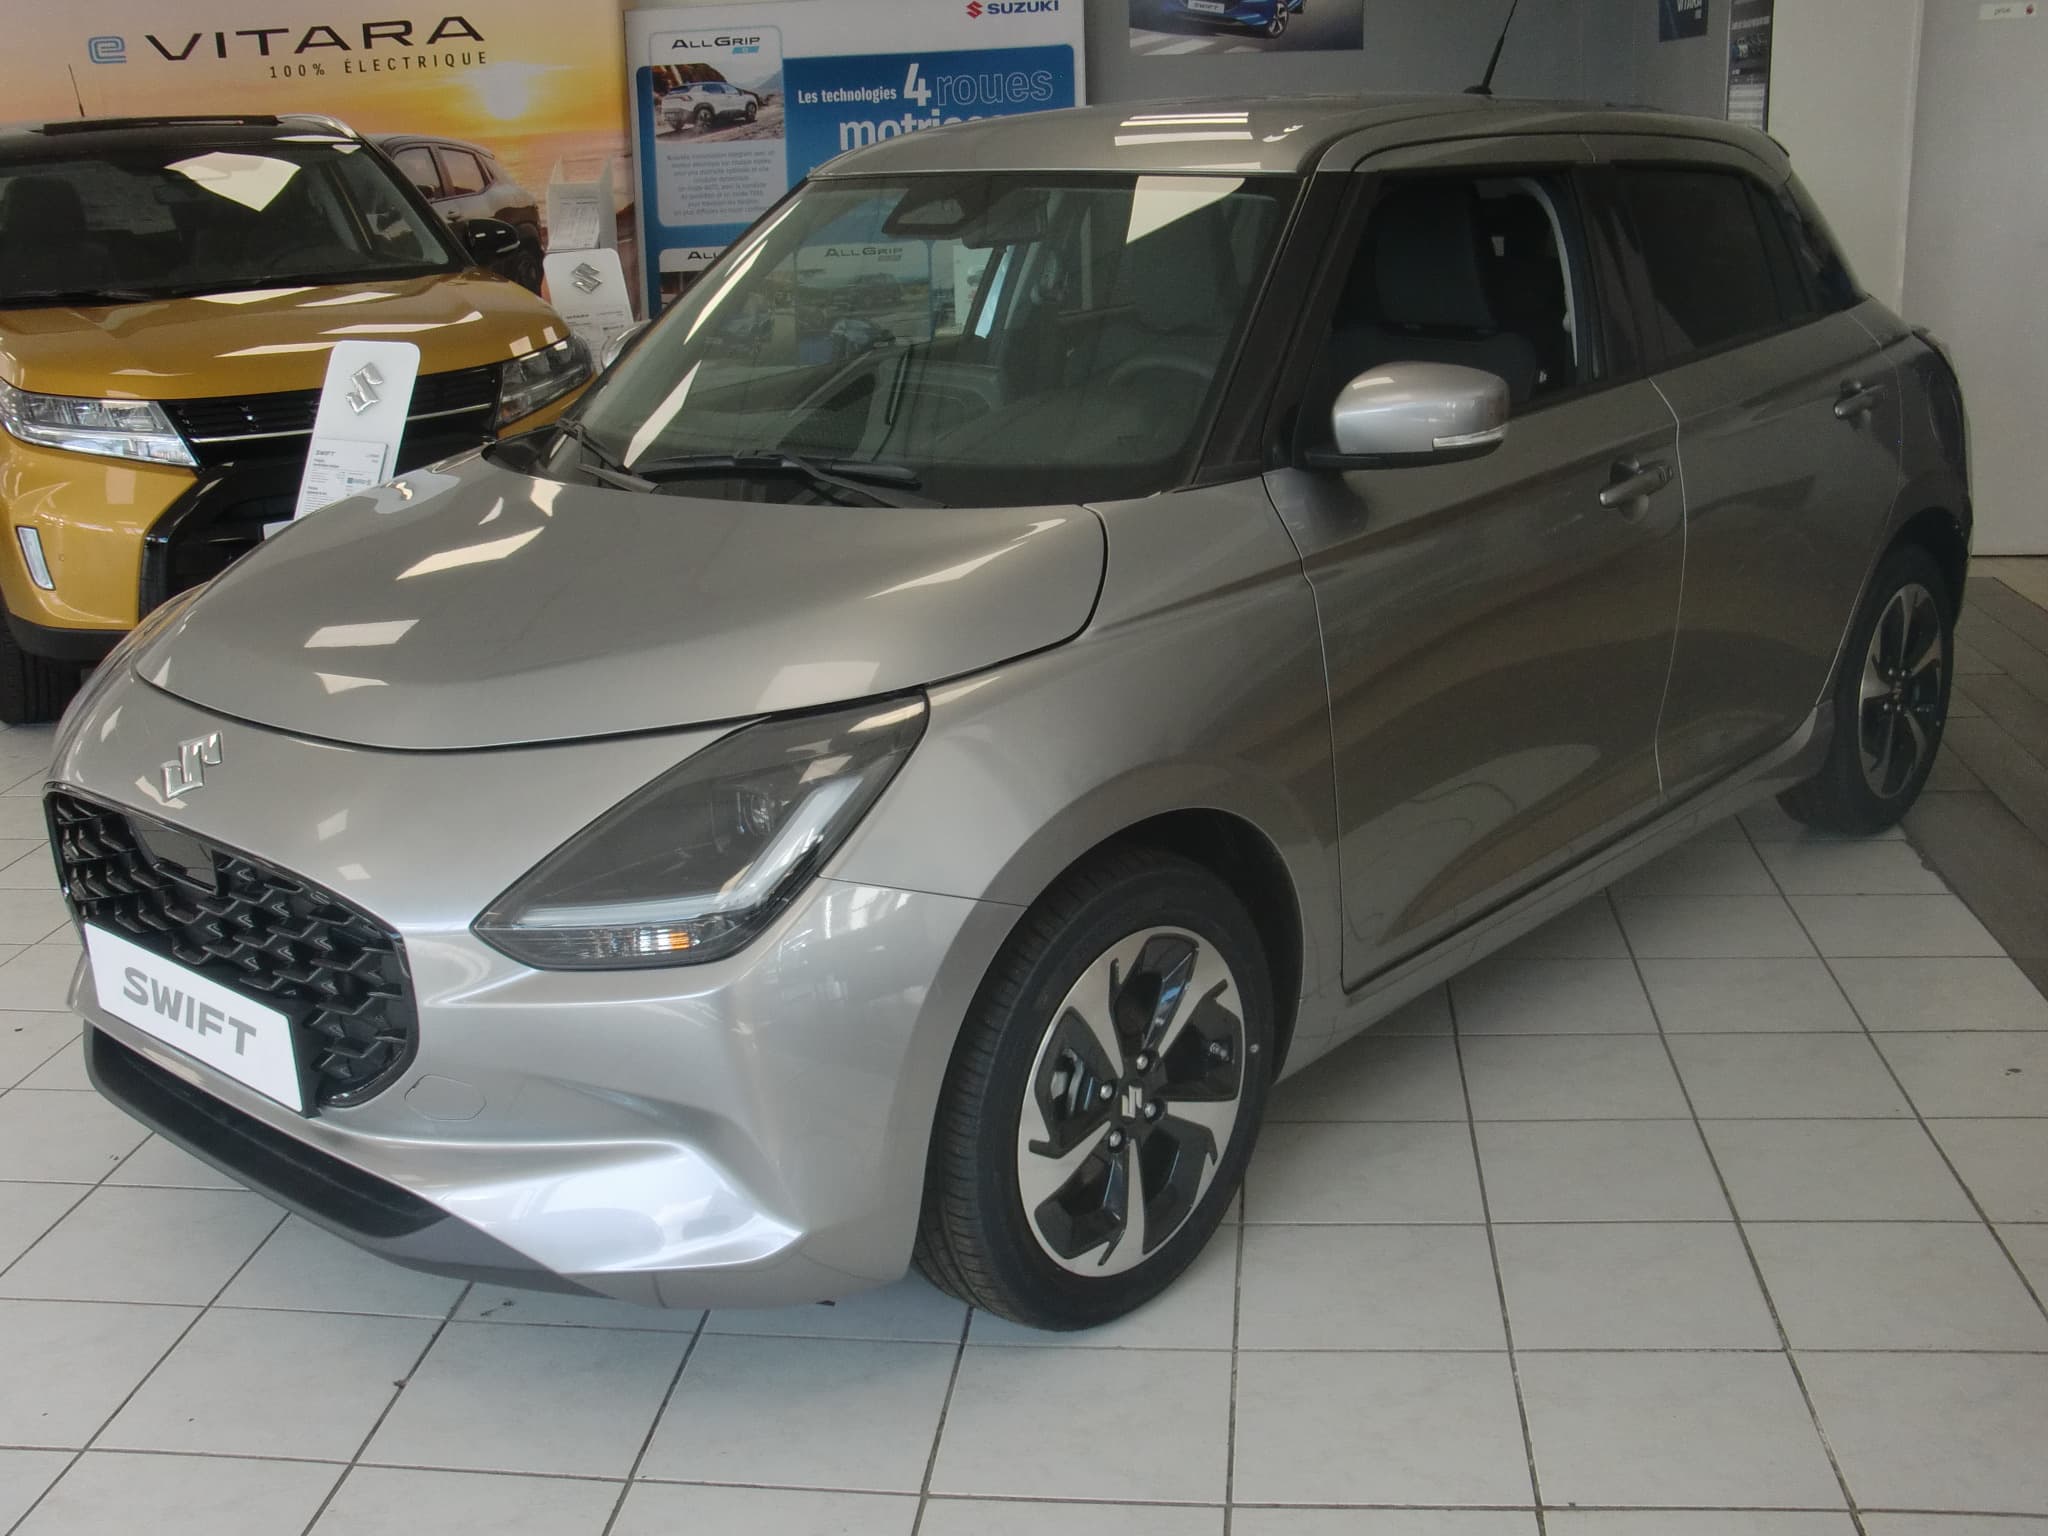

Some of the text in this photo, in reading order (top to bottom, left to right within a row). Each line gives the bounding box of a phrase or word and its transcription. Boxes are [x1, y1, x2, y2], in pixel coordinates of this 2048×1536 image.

[987, 0, 1060, 15] SUZUKI
[144, 16, 486, 61] VITARA
[269, 51, 488, 79] 100% ÉLECTRIQUE
[797, 63, 1054, 107] Les technologies 4 roues
[839, 109, 1006, 151] motri
[122, 966, 257, 1056] SWIFT
